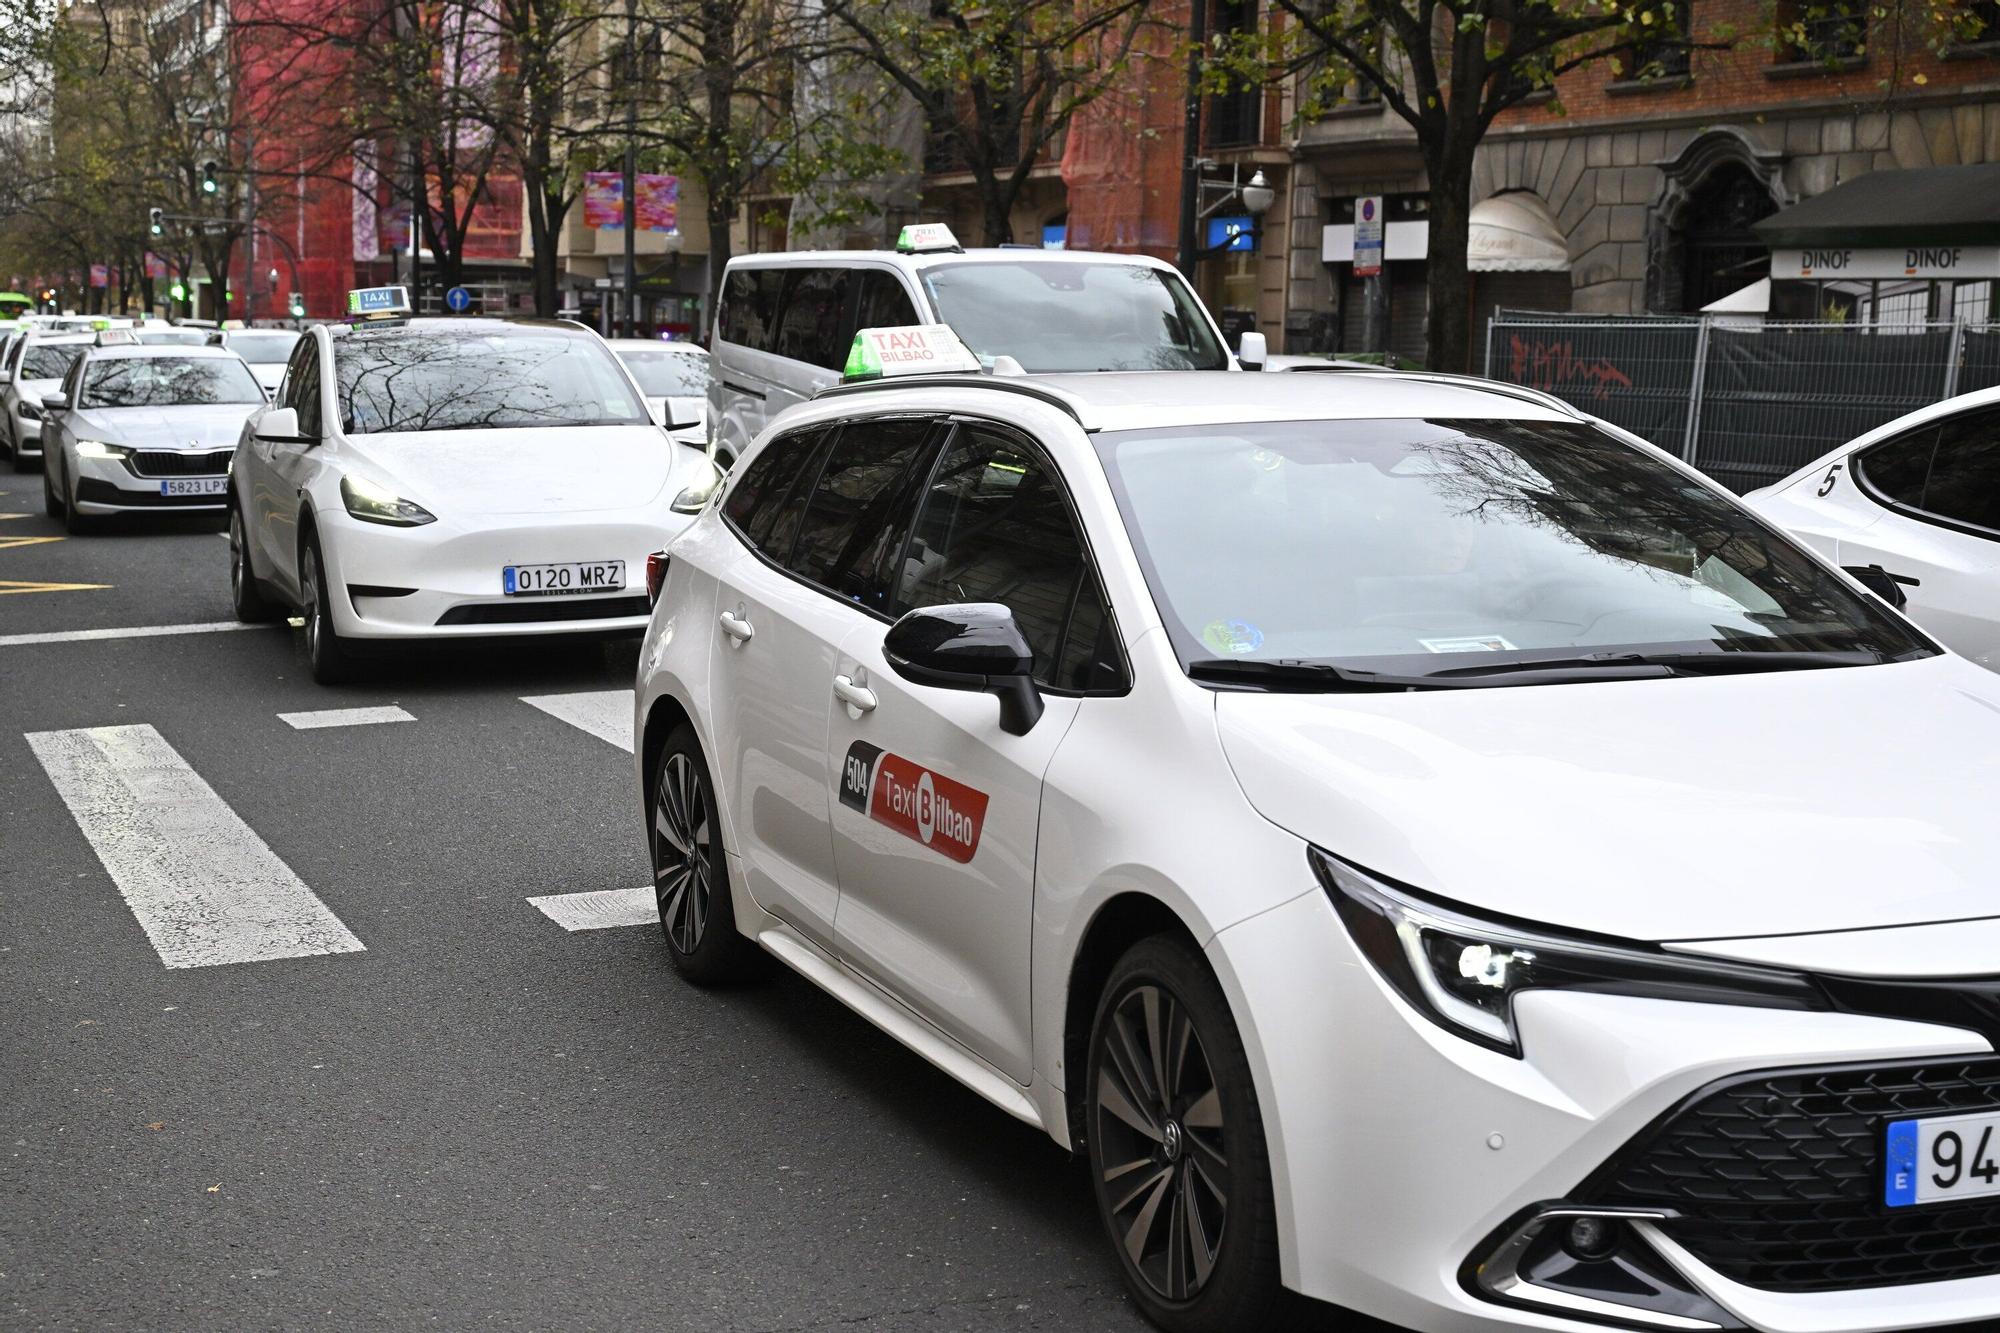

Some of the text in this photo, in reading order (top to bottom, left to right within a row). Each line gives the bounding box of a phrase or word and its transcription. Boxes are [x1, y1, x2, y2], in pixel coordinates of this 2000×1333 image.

[1802, 250, 1851, 269] DINOF
[1906, 249, 1960, 268] DINOF
[363, 291, 390, 302] TAXI
[872, 331, 927, 350] TAXI
[880, 349, 934, 362] BILBAO
[169, 481, 201, 494] 5823
[1818, 464, 1843, 497] 5
[519, 565, 620, 589] 0120 MRZ
[847, 755, 868, 797] 504
[1931, 1126, 1999, 1190] 94
[1895, 1173, 1908, 1190] E
